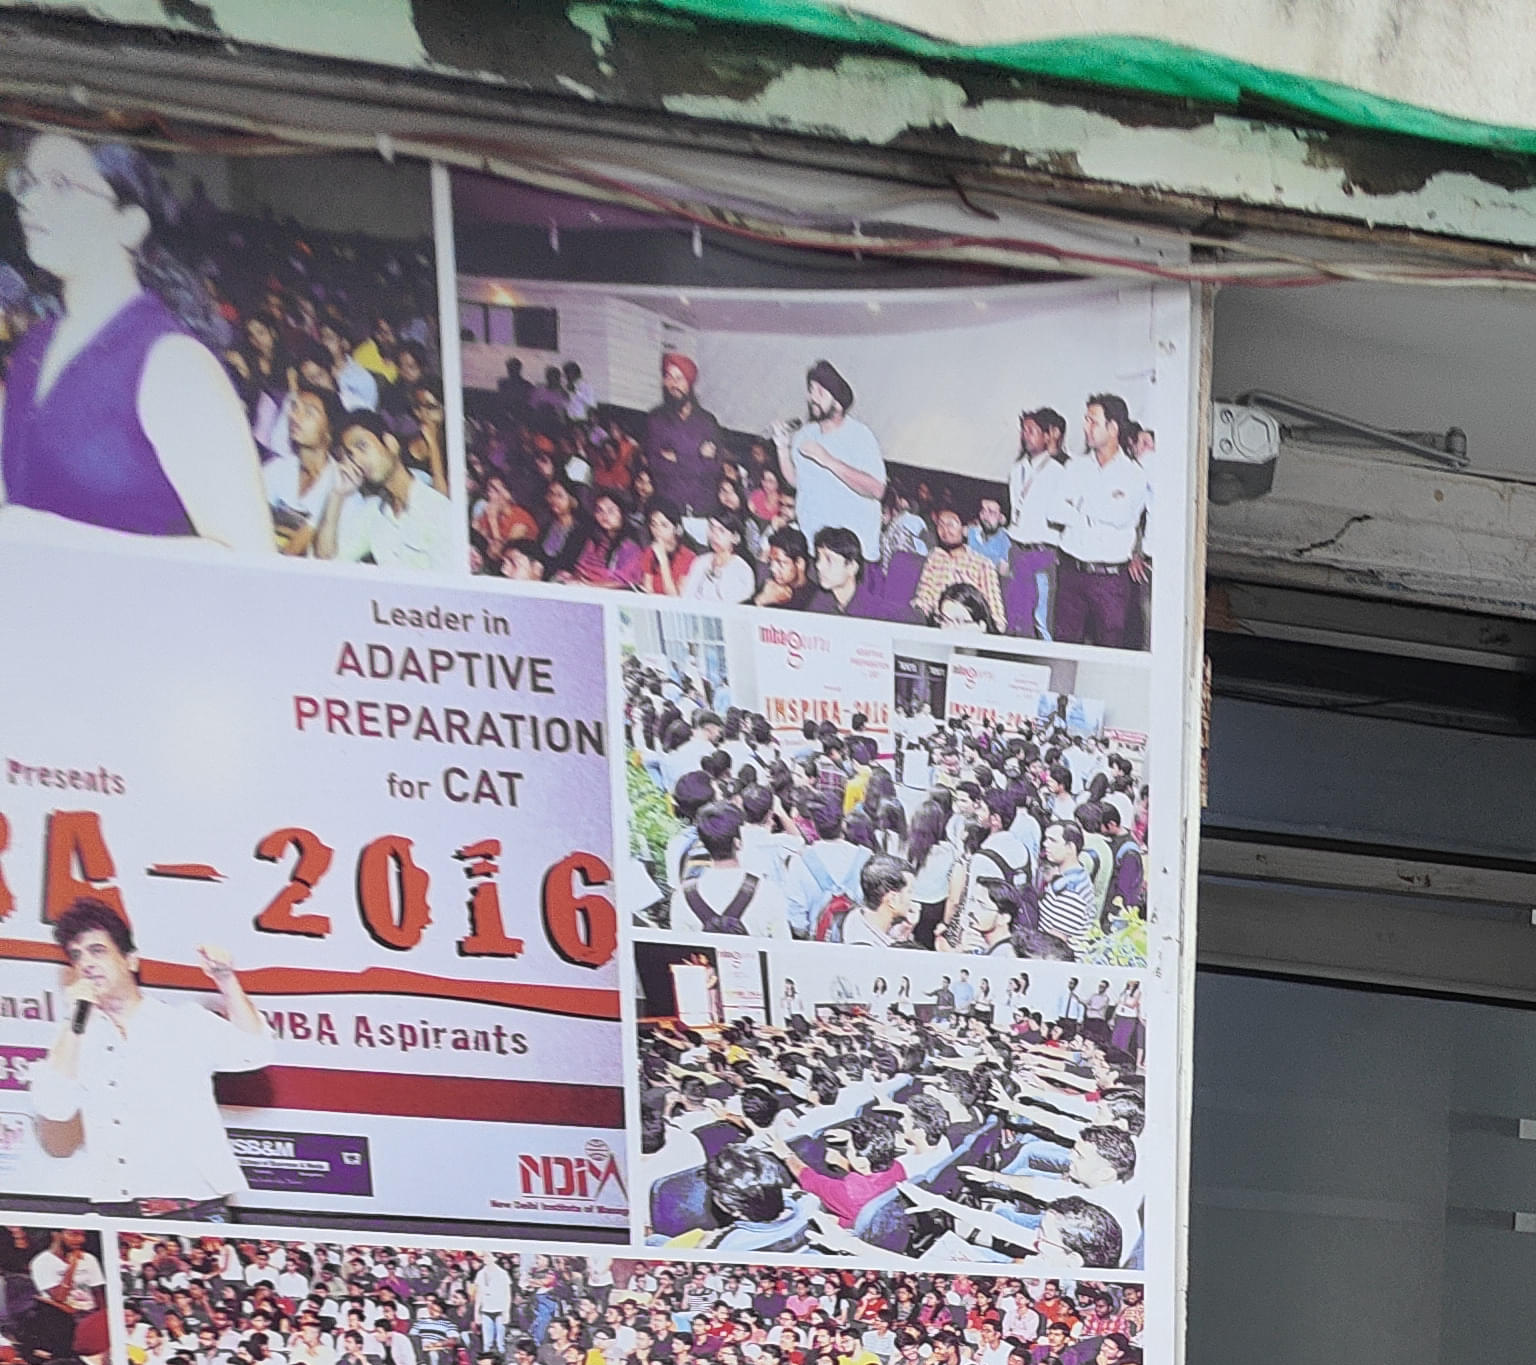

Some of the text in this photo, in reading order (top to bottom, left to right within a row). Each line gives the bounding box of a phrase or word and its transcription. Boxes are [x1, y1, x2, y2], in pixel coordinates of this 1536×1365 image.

[371, 599, 511, 636] Leader in
[336, 641, 555, 694] ADAPTIVE
[292, 695, 607, 758] PREPARATION
[5, 757, 126, 796] Presents
[386, 766, 524, 807] for CAT
[353, 1014, 529, 1056] Aspirants
